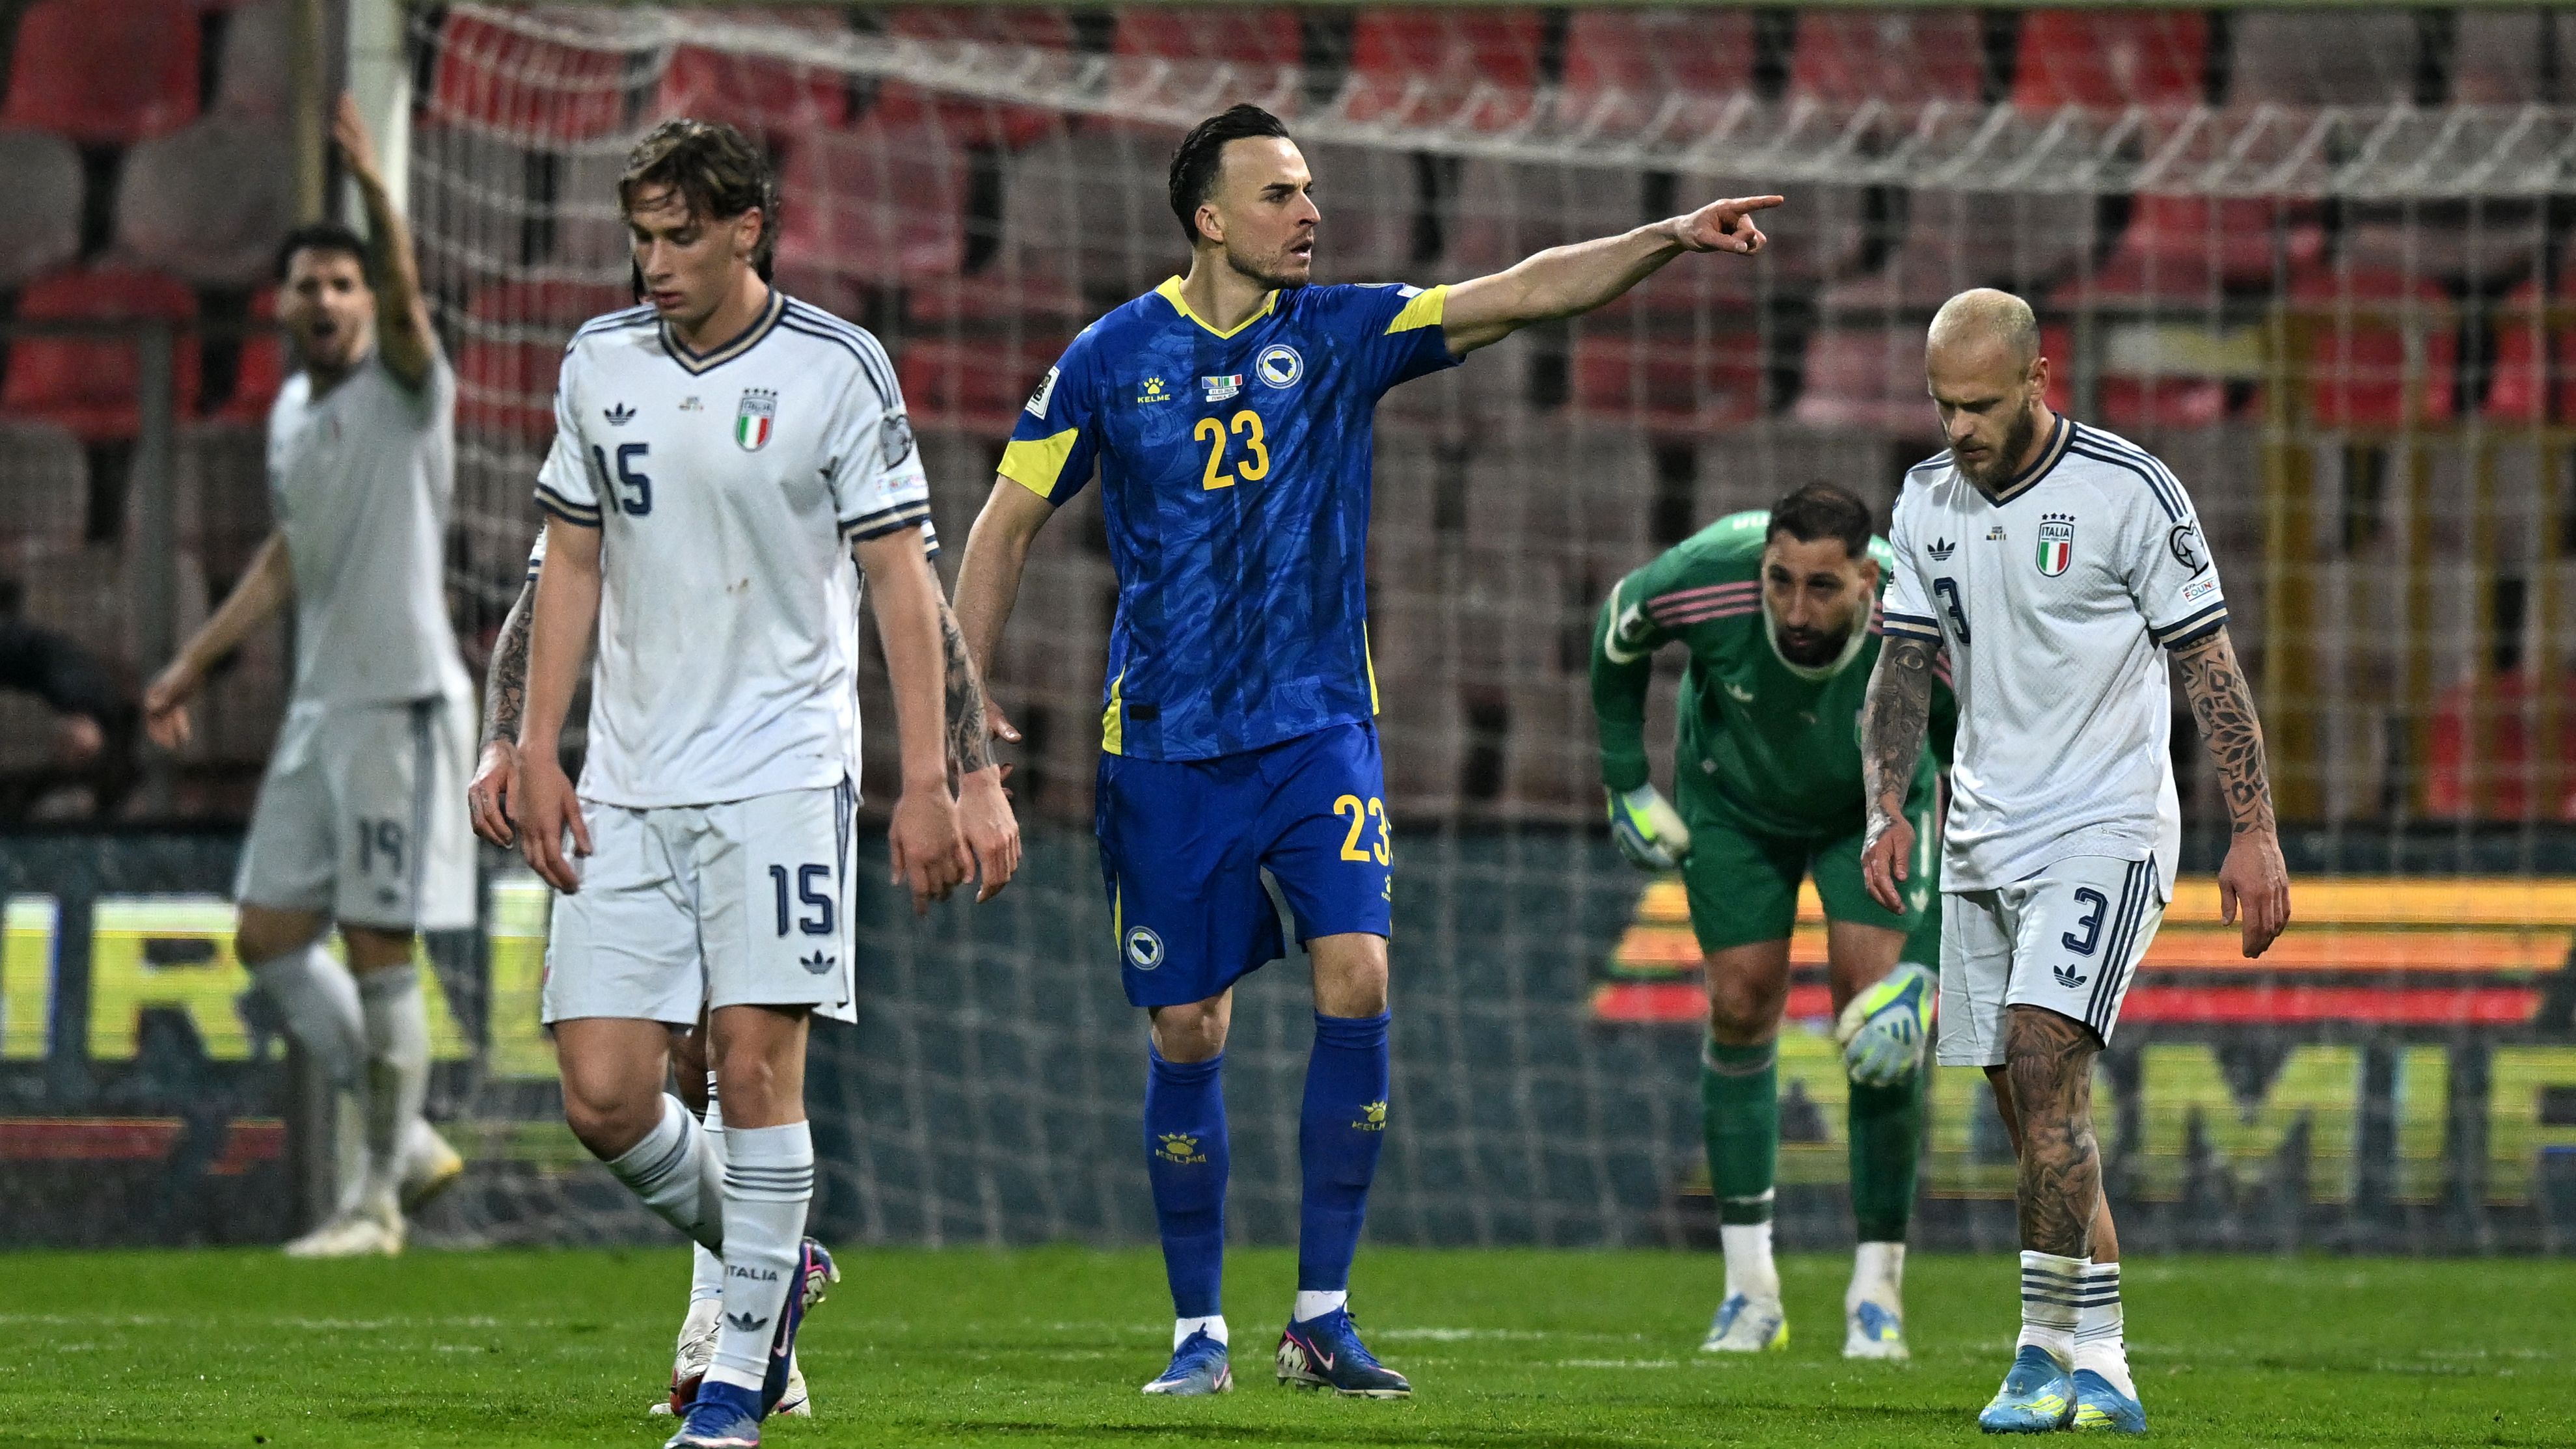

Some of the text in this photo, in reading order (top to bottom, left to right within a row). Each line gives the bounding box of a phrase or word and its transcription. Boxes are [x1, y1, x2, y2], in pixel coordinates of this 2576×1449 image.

[1137, 394, 1171, 403] KELME
[593, 443, 652, 515] 15
[1194, 410, 1269, 491] 23
[2042, 526, 2070, 537] ITALIA
[1933, 576, 1971, 645] 3
[359, 818, 403, 876] 19
[1333, 794, 1390, 866] 23
[769, 863, 834, 936] 15
[2061, 886, 2109, 958] 3
[1156, 1148, 1207, 1165] KELME
[1352, 1120, 1387, 1131] KELM
[725, 1265, 778, 1281] ITALIA
